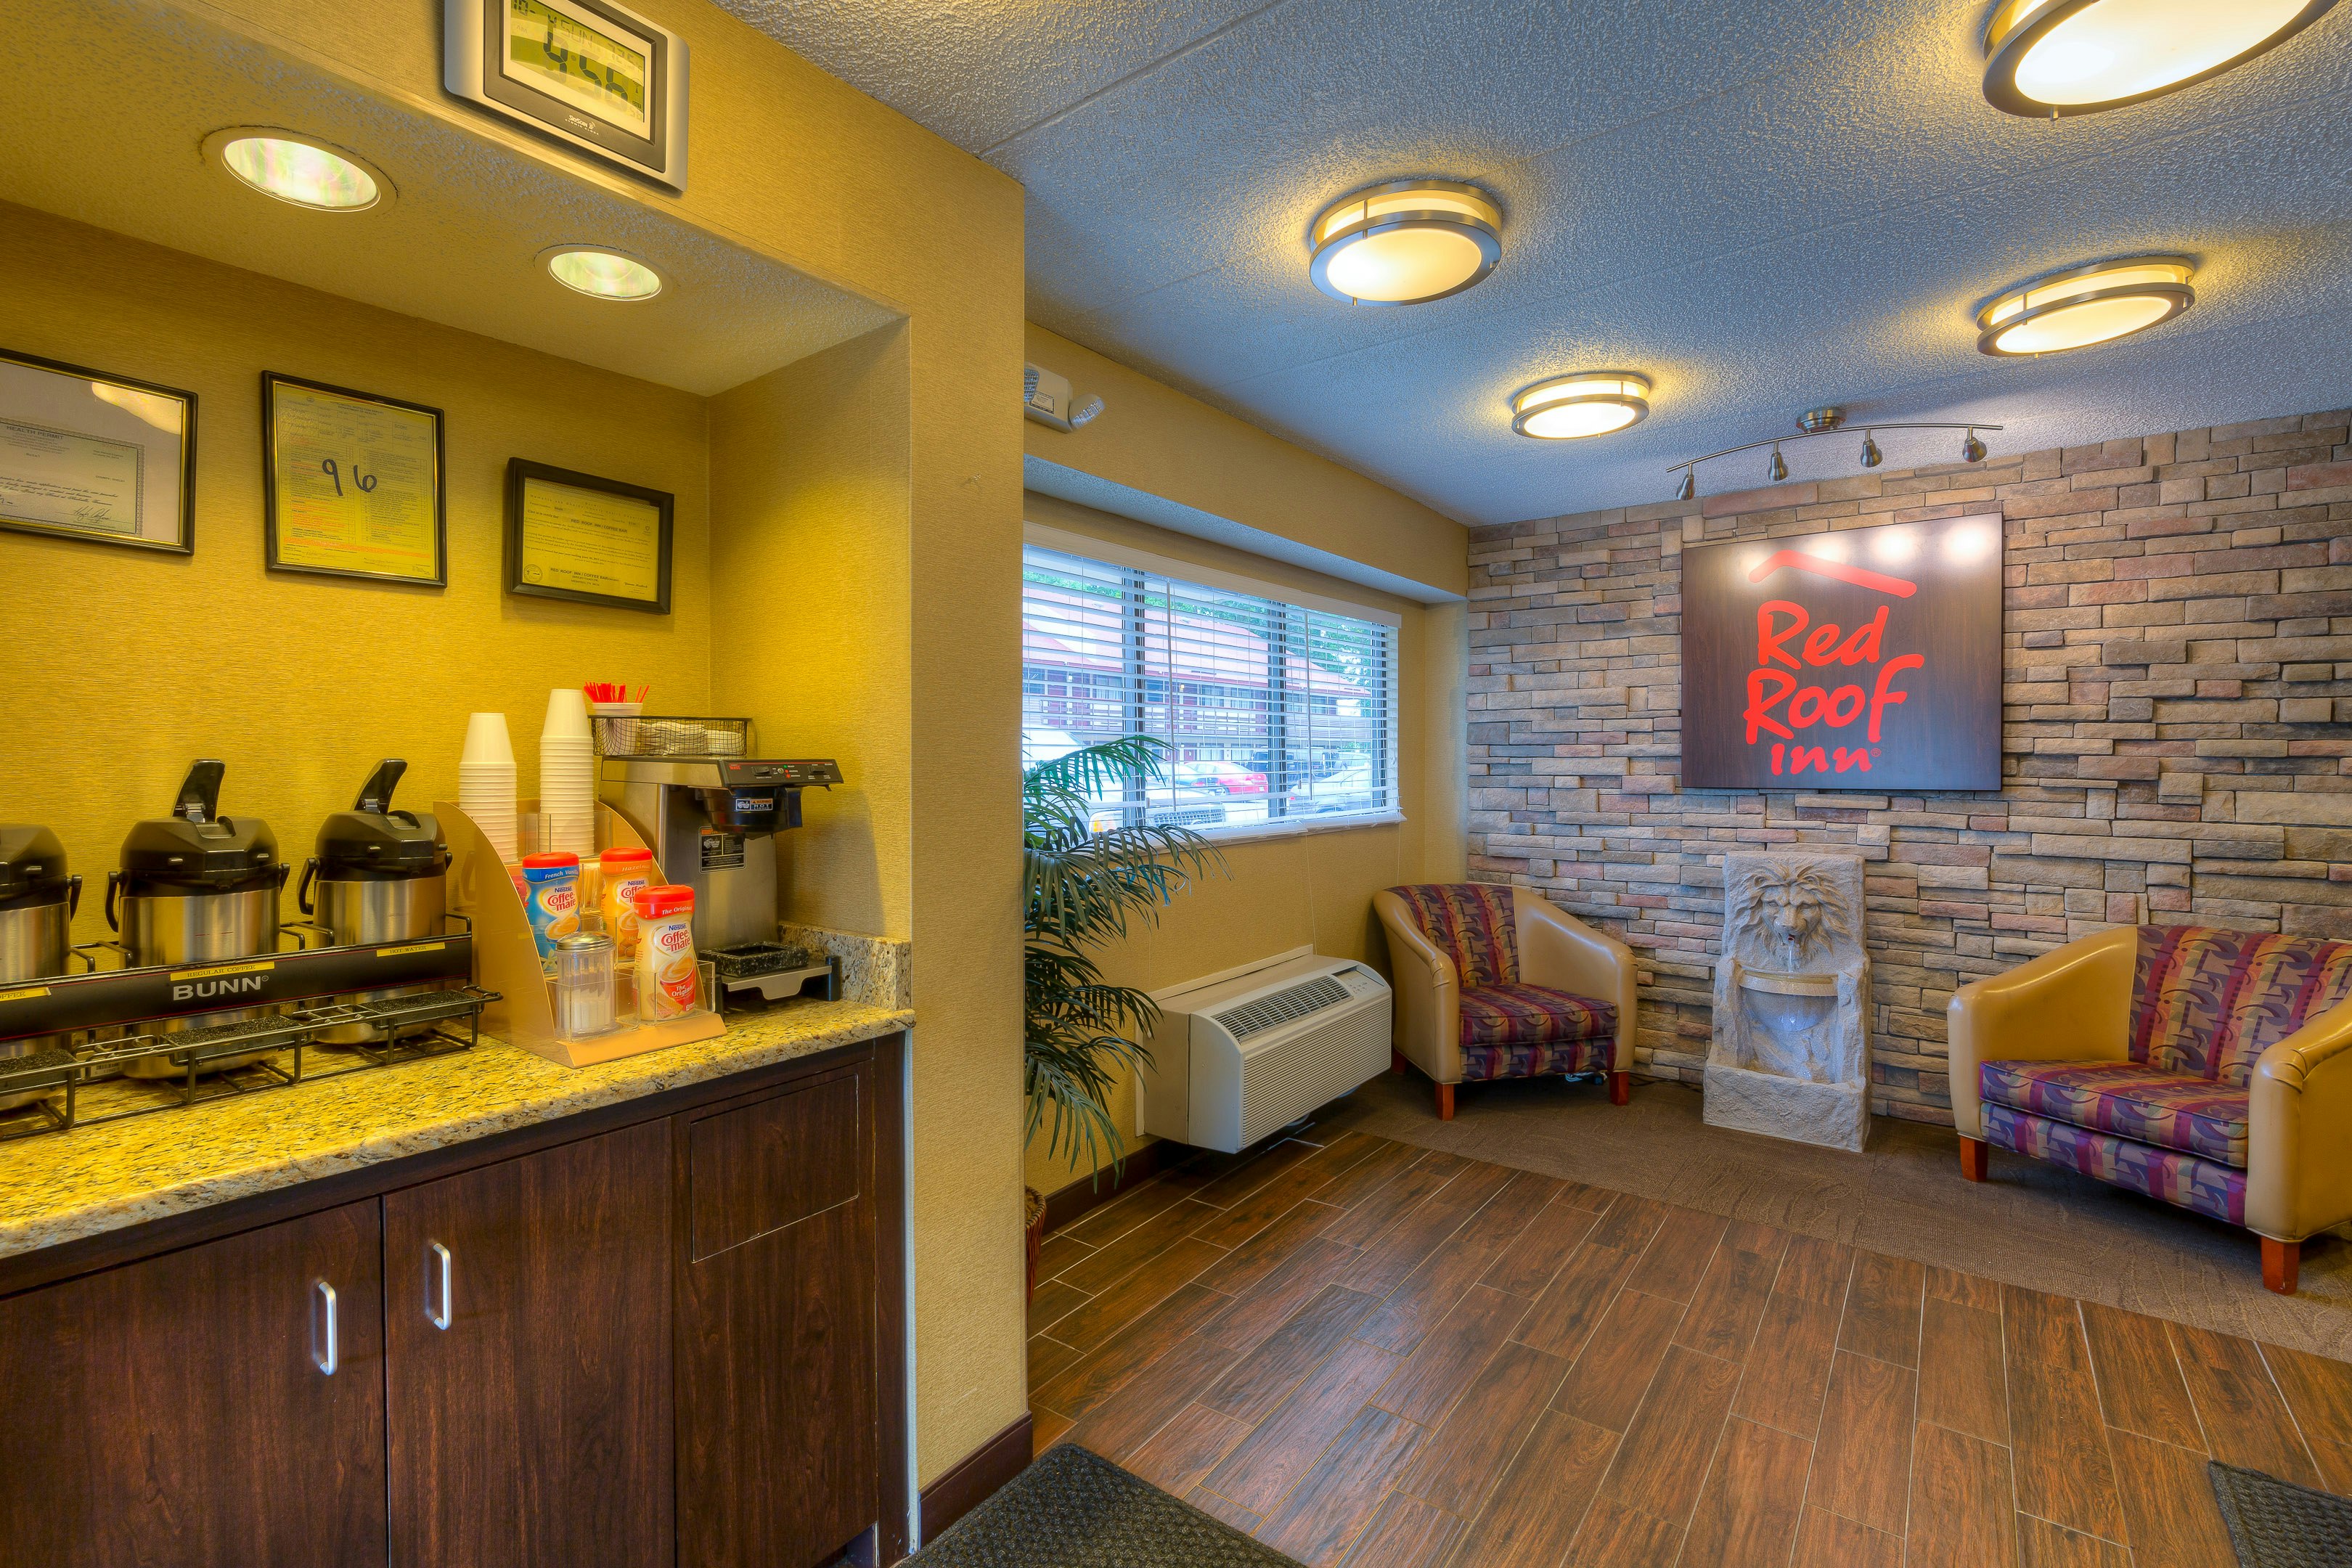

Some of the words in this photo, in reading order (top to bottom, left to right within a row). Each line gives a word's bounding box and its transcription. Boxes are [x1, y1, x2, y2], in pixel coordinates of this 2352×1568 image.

[7, 425, 36, 435] HEALTH
[37, 430, 64, 440] PERMIT
[322, 458, 377, 497] 96
[1757, 600, 1890, 670] Red
[1743, 653, 1925, 745] Roof
[544, 870, 564, 879] French
[556, 899, 576, 911] mate
[670, 936, 691, 952] mate
[187, 968, 225, 978] REGULAR
[173, 976, 261, 1001] BUNN
[671, 981, 693, 997] Original
